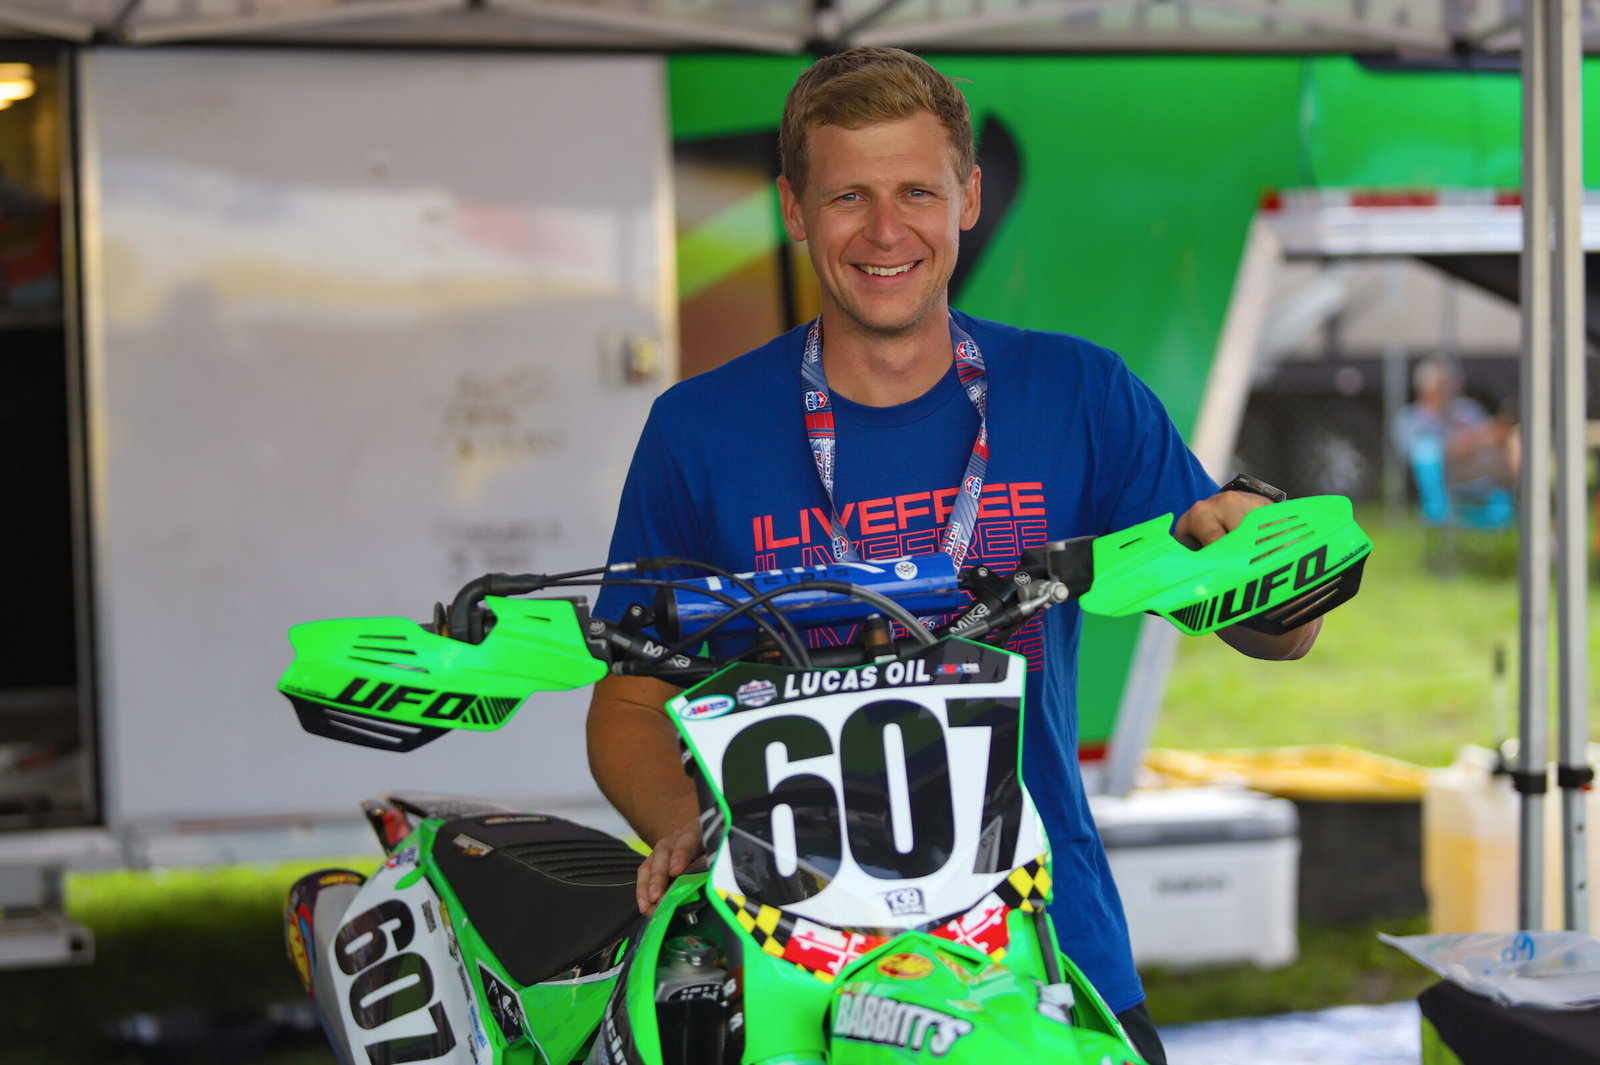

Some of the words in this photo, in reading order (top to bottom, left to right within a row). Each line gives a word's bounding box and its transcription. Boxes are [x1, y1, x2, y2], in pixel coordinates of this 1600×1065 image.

[1217, 544, 1328, 624] UFO
[335, 677, 479, 722] UFO
[783, 664, 878, 699] LUCAS
[884, 658, 931, 684] OIL
[721, 695, 1023, 906] 607
[334, 898, 457, 1065] 607
